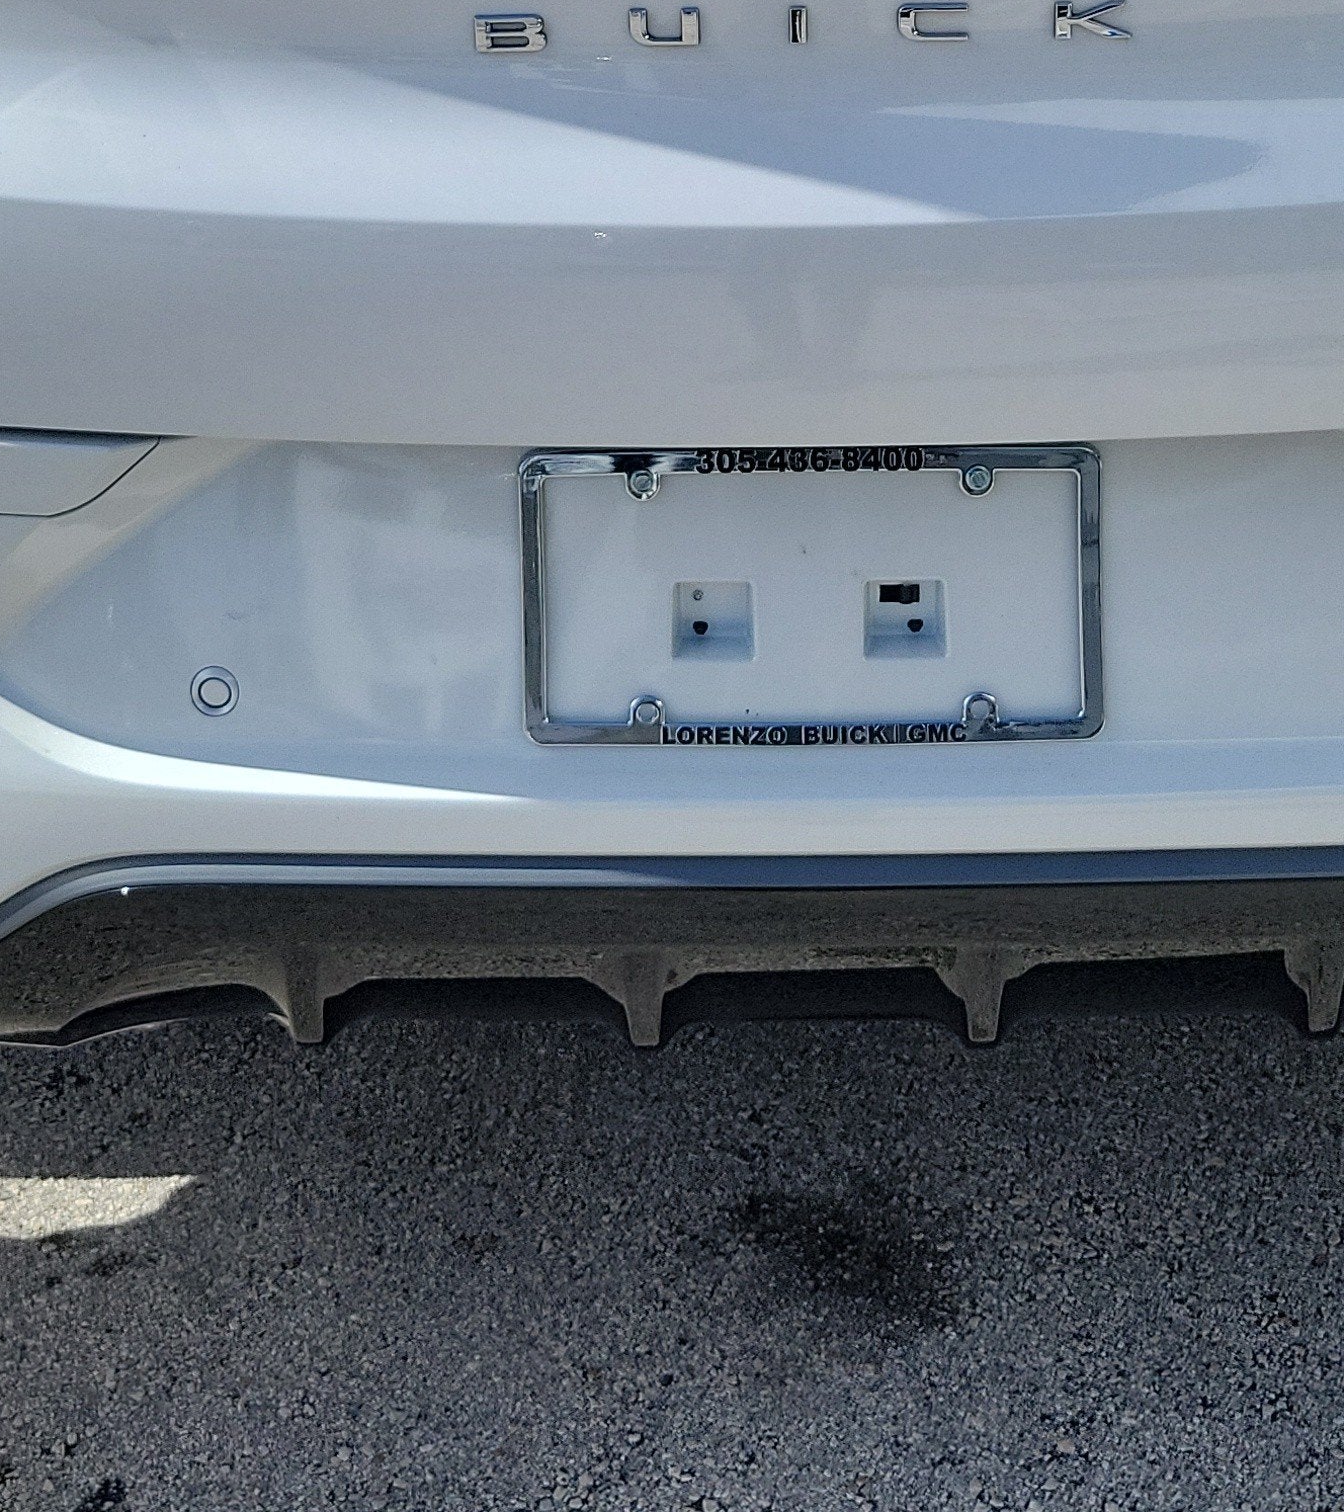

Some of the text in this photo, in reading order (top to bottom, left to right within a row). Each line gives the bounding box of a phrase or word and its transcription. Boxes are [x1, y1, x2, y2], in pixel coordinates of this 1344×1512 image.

[473, 0, 1134, 54] BUICK
[661, 722, 968, 746] LORENZO BUICK GMC
